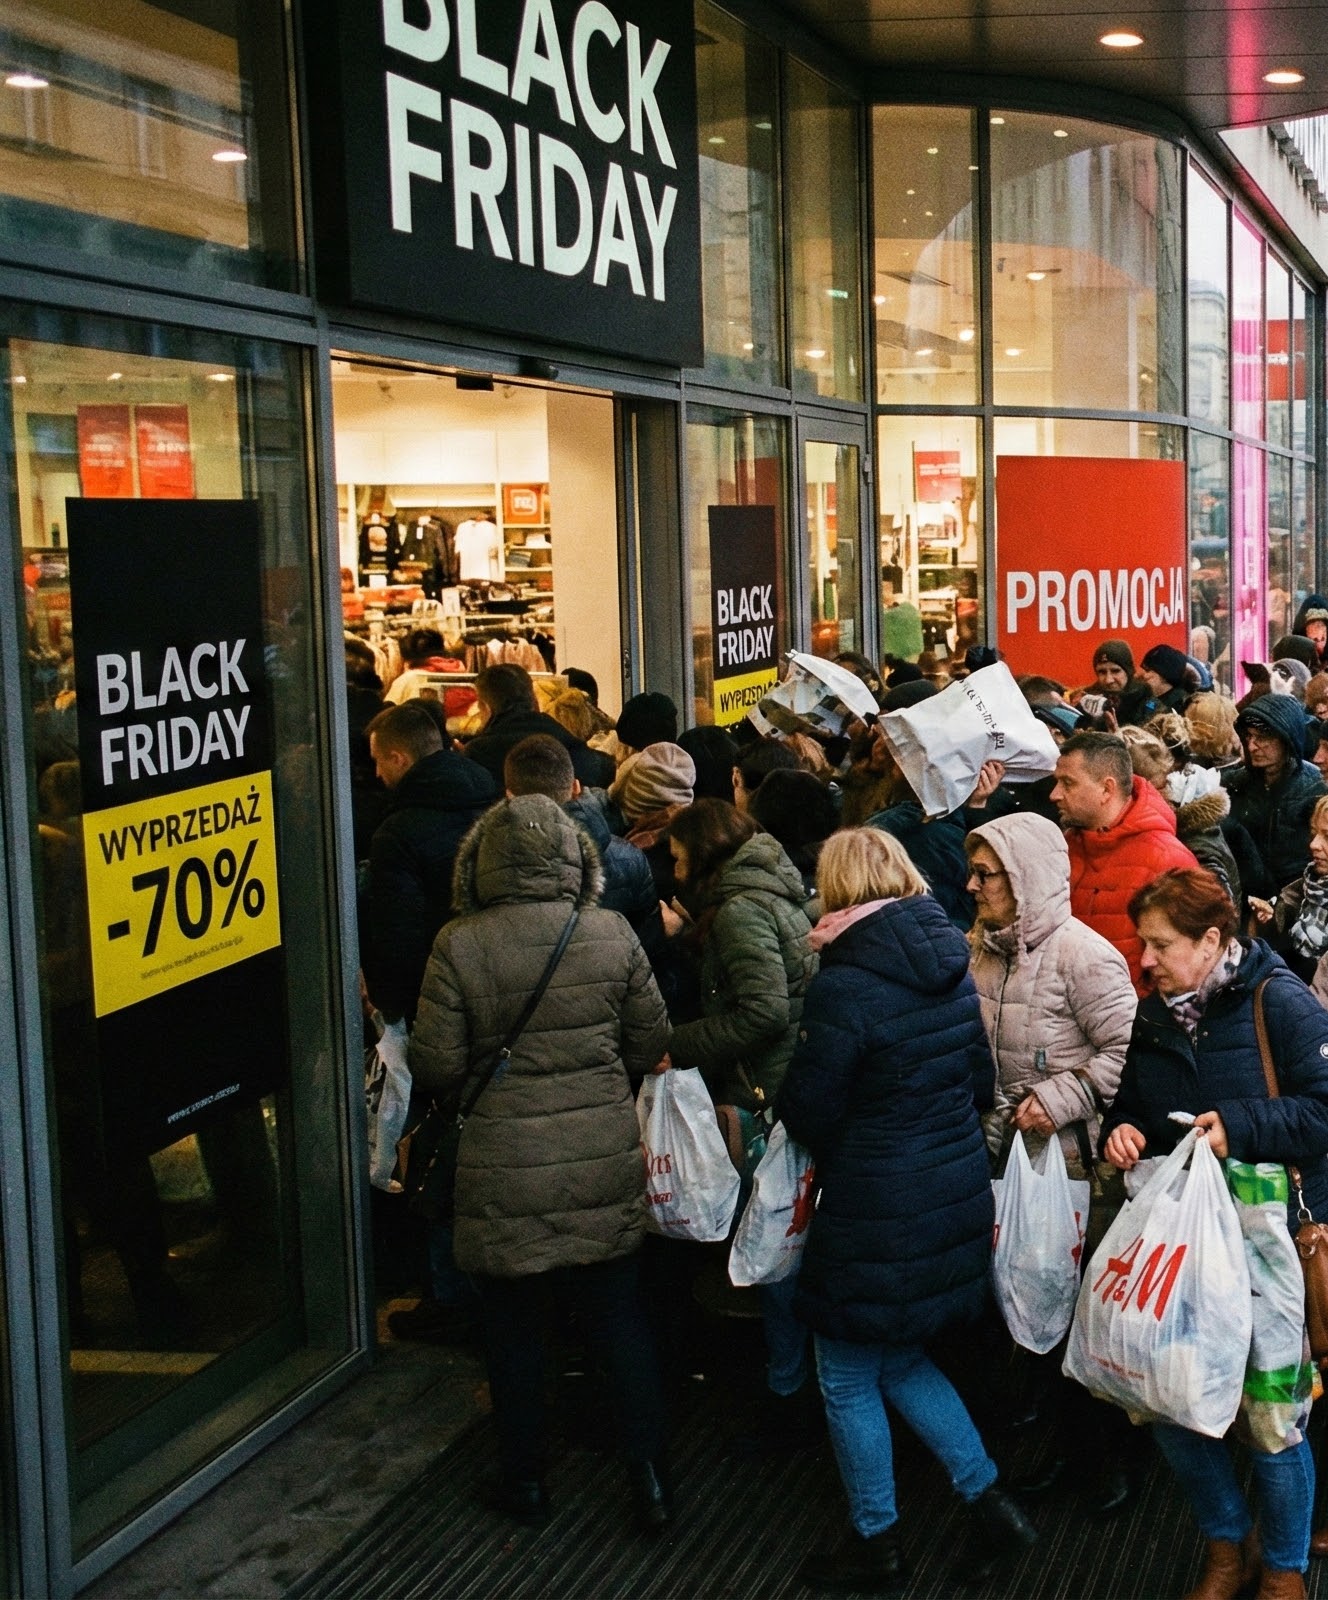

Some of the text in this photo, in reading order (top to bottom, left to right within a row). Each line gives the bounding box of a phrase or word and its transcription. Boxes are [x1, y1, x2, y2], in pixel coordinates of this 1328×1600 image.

[385, 70, 679, 302] FRIDAY
[717, 584, 774, 626] BLACK
[1006, 566, 1185, 634] PROMOCJA
[96, 638, 250, 716] BLACK
[718, 625, 774, 667] FRIDAY
[100, 705, 251, 786] FRIDAY
[98, 784, 262, 865] WYPRZEDAŻ
[107, 838, 266, 959] -70%
